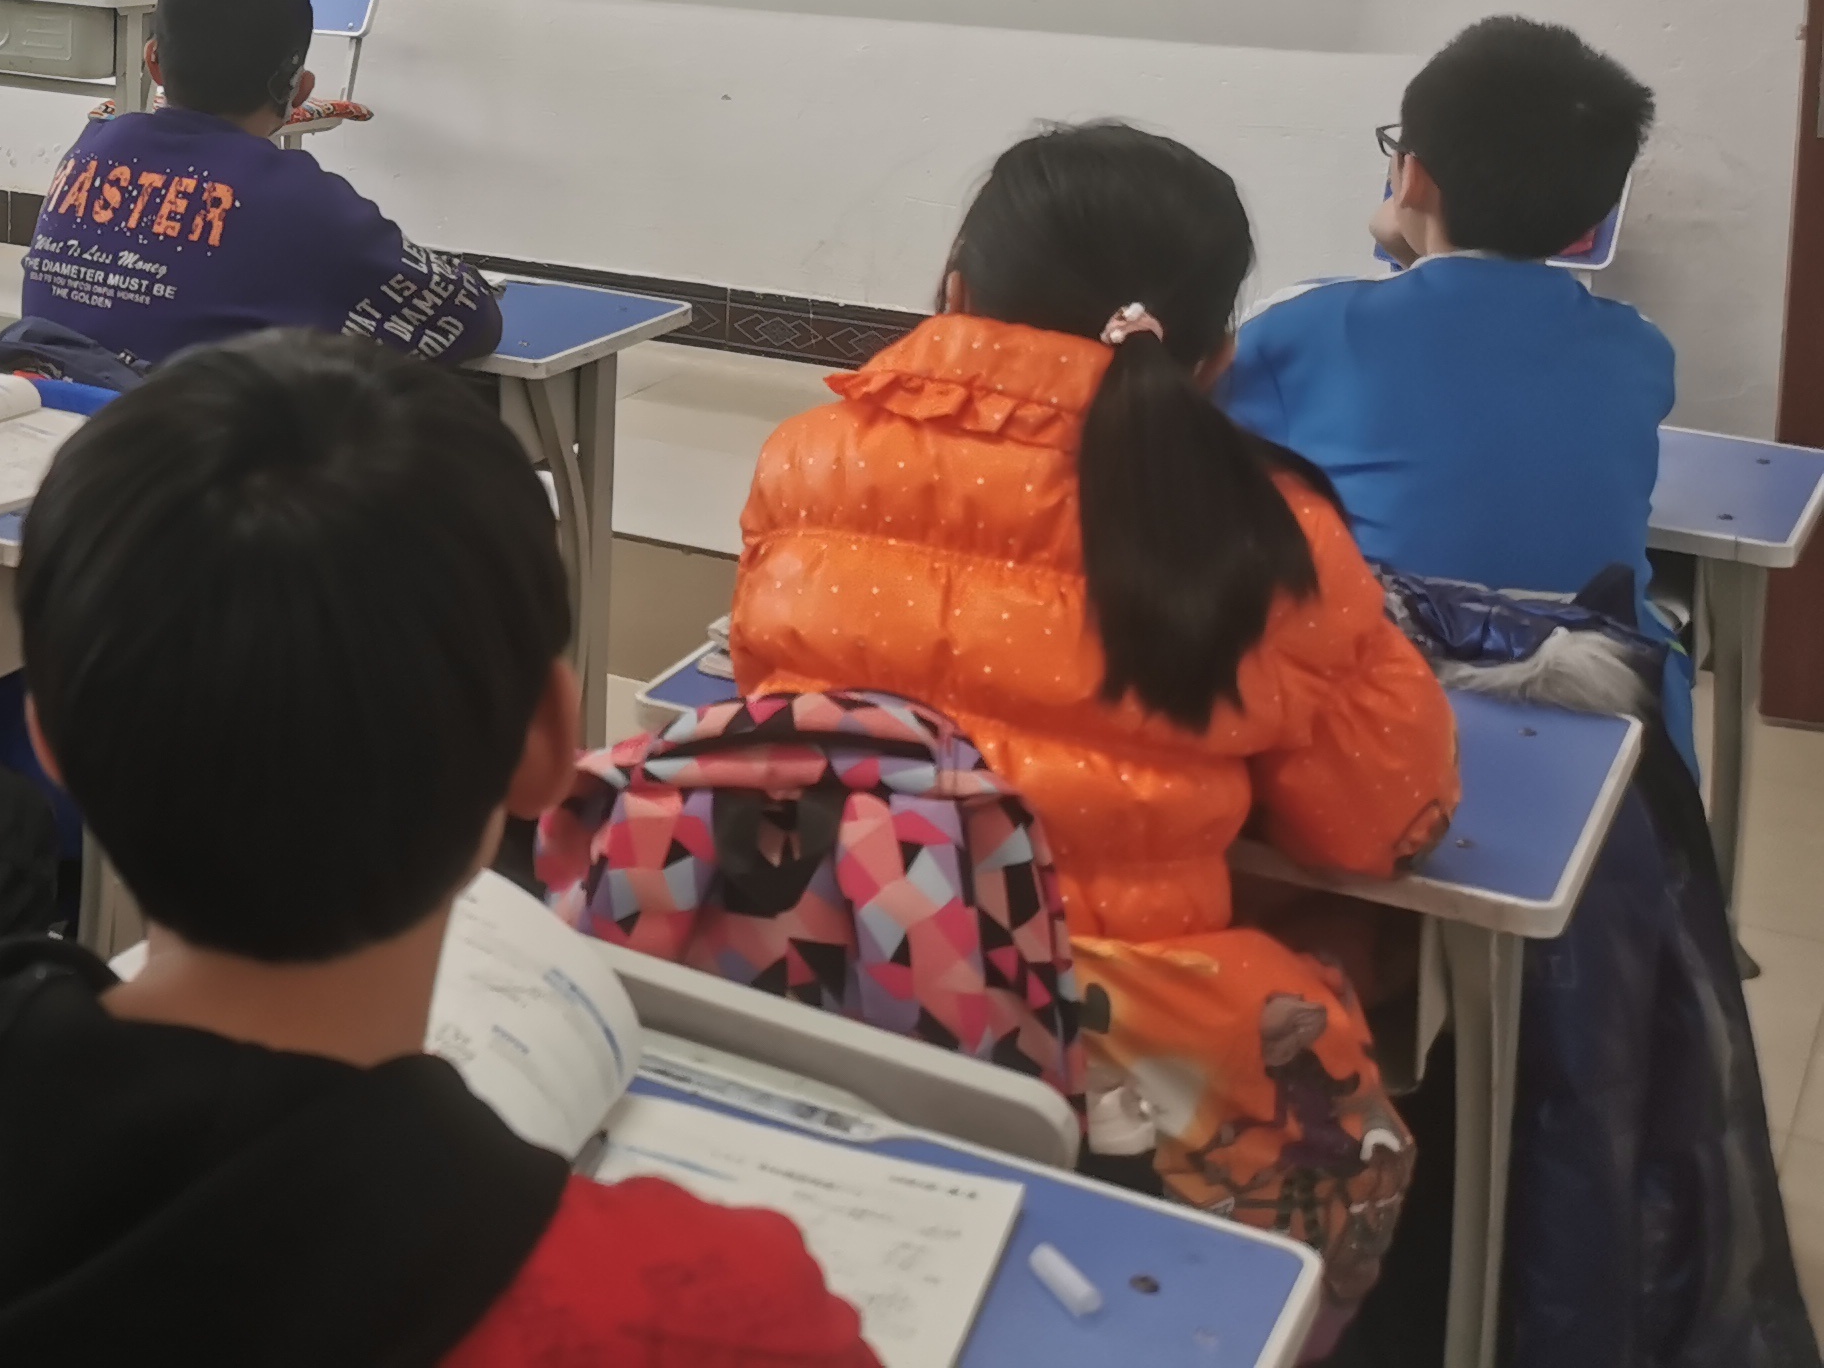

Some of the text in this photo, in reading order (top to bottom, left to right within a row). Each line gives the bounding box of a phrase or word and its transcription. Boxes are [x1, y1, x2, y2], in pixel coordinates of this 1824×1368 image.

[46, 157, 234, 247] MASTER
[41, 258, 105, 284] DIAMETER
[106, 272, 151, 295] MUST
[152, 283, 177, 300] BE
[117, 250, 168, 279] Money
[52, 284, 113, 309] THE GOLDEN
[380, 273, 418, 305] IS
